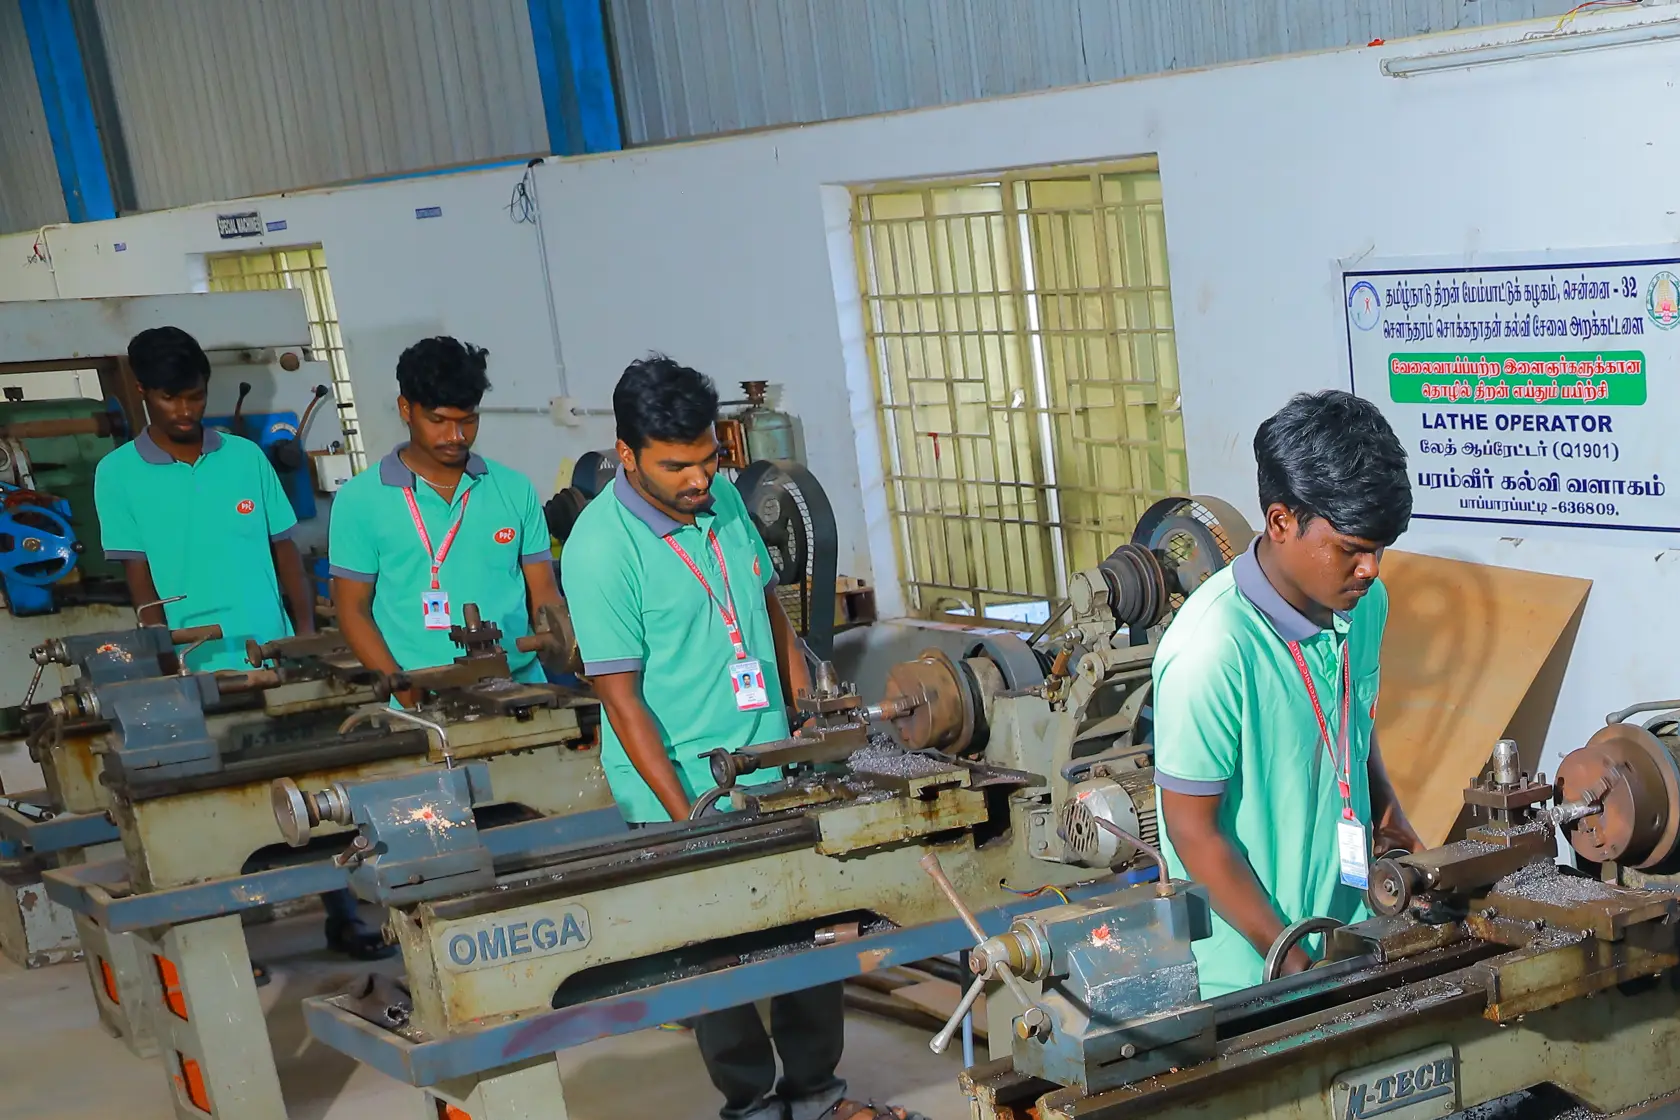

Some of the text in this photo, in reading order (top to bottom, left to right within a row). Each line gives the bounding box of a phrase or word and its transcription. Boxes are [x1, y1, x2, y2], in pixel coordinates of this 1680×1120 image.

[1385, 279, 1431, 310] தமிழ்நாடு
[1434, 278, 1459, 310] திறன்
[1563, 273, 1610, 301] சென்னை
[1622, 276, 1638, 298] 32
[1504, 312, 1530, 337] கல்வி
[1533, 314, 1567, 337] சேவை
[1422, 379, 1609, 403] தொழில் திறன் எய்தும் பயிற்சி
[1422, 413, 1613, 433] LATHE OPERATOR
[1420, 438, 1619, 462] லேத் ஆப்ரேட்டர் (Q1901)
[1418, 467, 1666, 497] பரம்வீர் கல்வி வளாகம்
[449, 913, 585, 966] OMEGA
